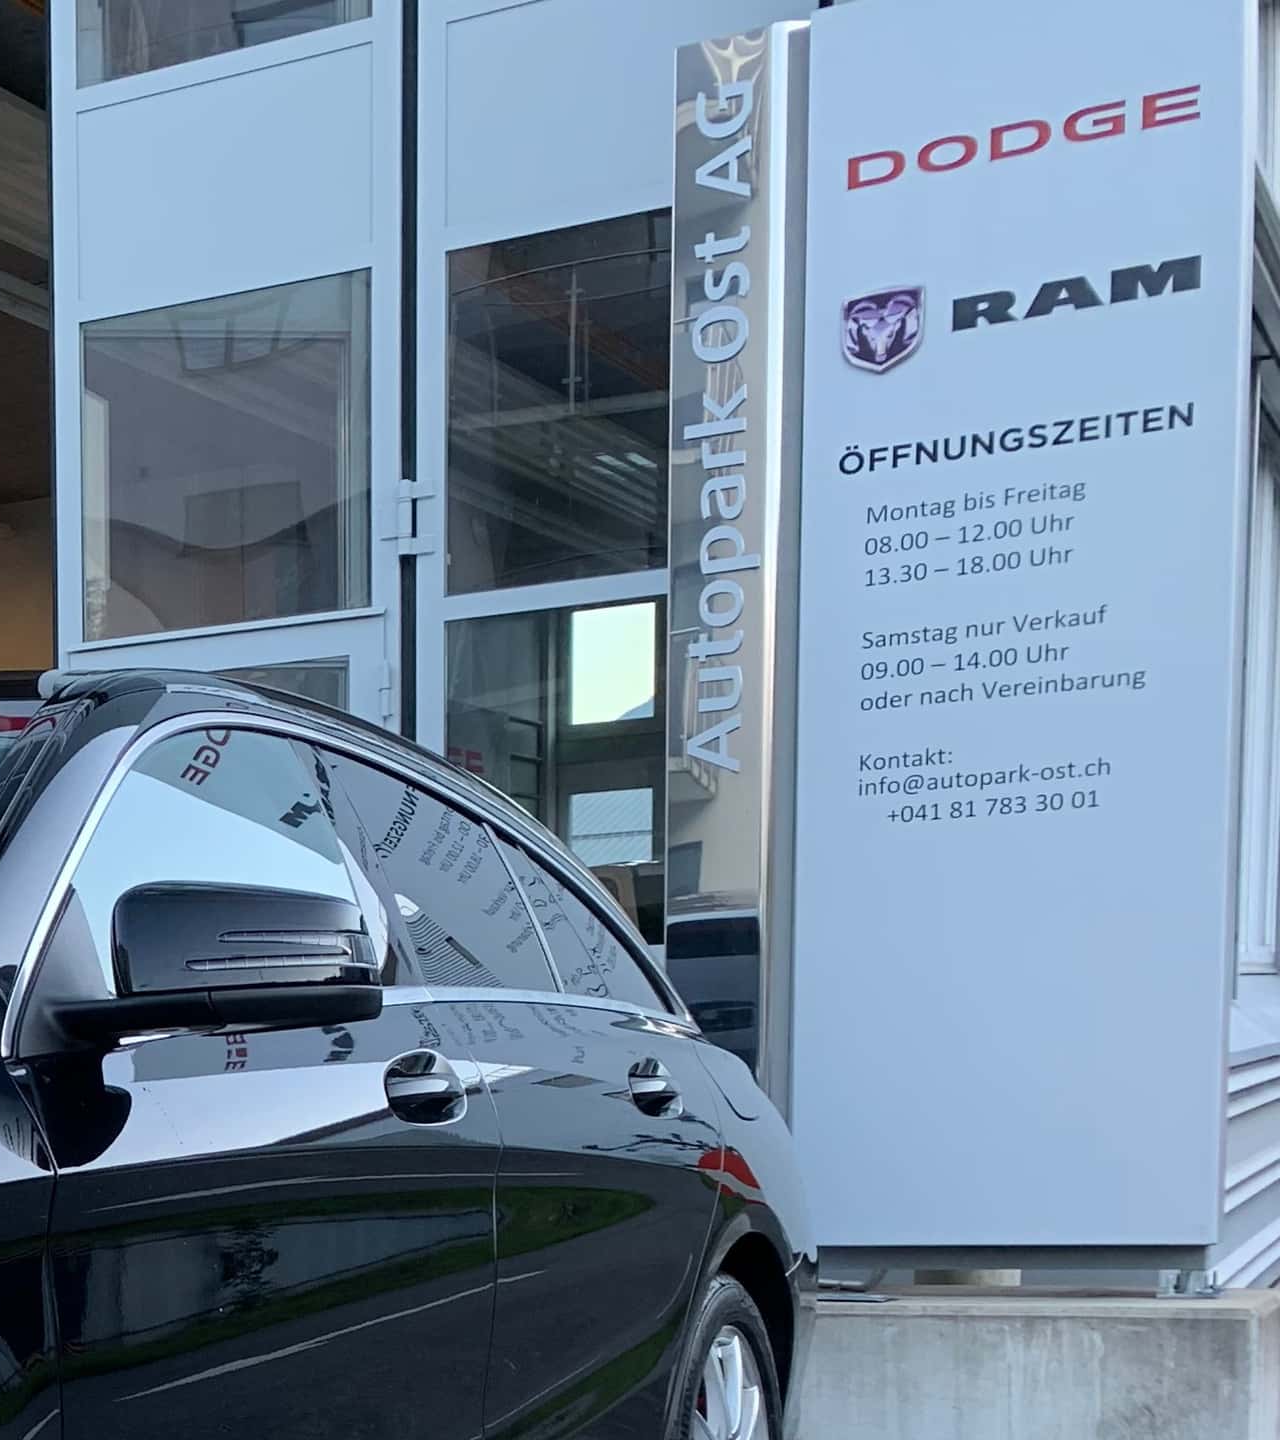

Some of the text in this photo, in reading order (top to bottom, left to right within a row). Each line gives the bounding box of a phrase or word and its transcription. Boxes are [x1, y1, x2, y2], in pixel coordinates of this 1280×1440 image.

[846, 84, 1202, 191] DODGE
[951, 254, 1202, 332] RAM
[683, 79, 761, 774] Autopark Ost AG
[838, 402, 1195, 476] ÖFFNUNGSZEITEN
[866, 481, 1087, 524] Montag bis Freitag
[864, 530, 929, 556] 08.00
[958, 518, 1023, 545] 12.00
[1031, 513, 1075, 535] Uhr
[864, 562, 928, 587] 13.30
[956, 551, 1022, 577] 18.00
[1029, 546, 1074, 568] Uhr
[861, 604, 1108, 650] Samstag nur Verkauf
[860, 657, 925, 681] 09.00
[953, 648, 1018, 673] 14.00
[1026, 643, 1070, 664] Uhr
[860, 670, 1147, 711] oder nach Vereinbarung
[858, 757, 1112, 797] info@autopark-ost.ch
[859, 747, 953, 772] Kontakt:
[887, 789, 1100, 823] +041 81 783 30 01
